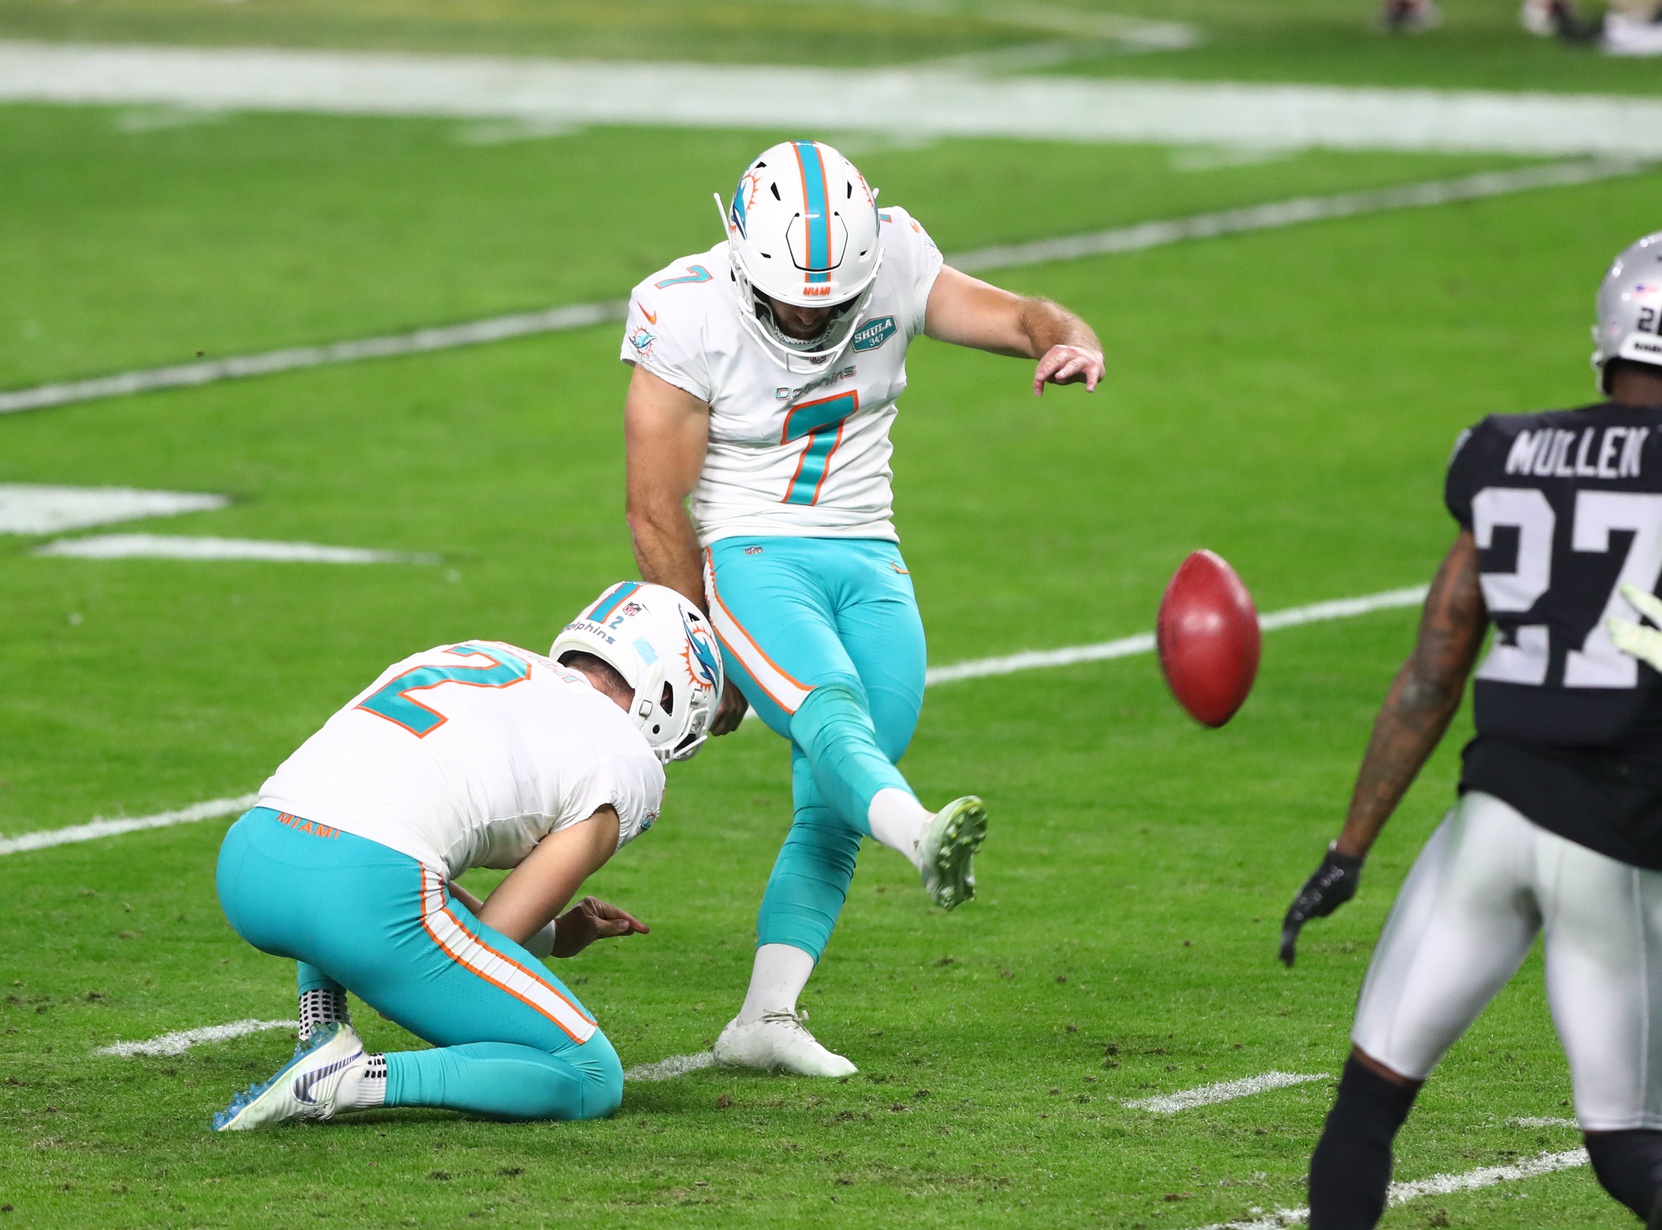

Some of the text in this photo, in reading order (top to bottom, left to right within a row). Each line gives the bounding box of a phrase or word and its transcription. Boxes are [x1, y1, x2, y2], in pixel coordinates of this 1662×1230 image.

[654, 264, 714, 290] 7
[803, 286, 831, 296] MIAMI
[854, 318, 893, 344] SHULA
[869, 333, 884, 347] 347
[780, 389, 860, 507] 7
[1505, 426, 1650, 479] MULLEN
[1472, 486, 1662, 689] 27
[560, 620, 616, 645] olphins
[609, 615, 625, 630] 2
[351, 643, 532, 740] 2
[276, 811, 342, 840] MIAMI
